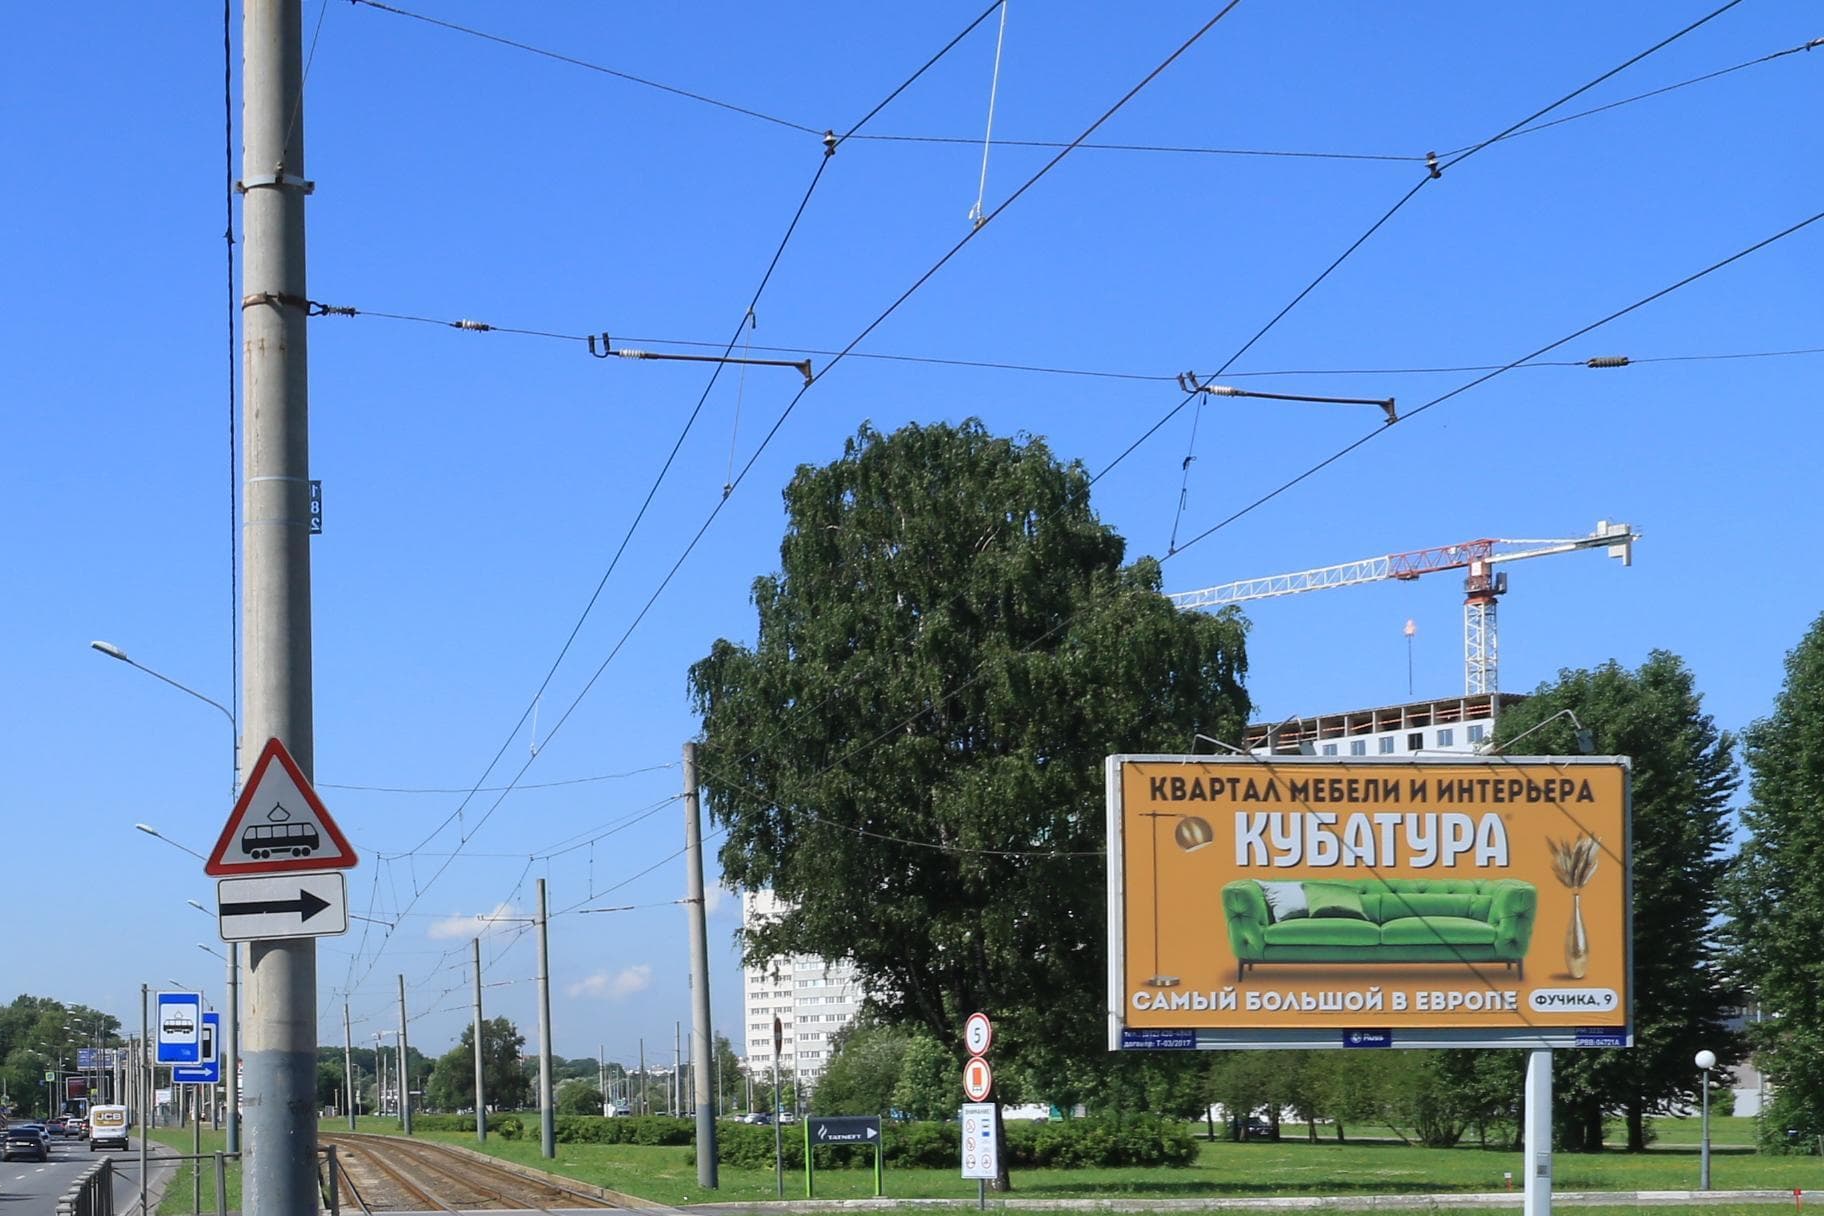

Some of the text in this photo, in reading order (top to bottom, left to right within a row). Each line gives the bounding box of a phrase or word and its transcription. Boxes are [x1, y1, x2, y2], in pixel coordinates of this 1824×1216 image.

[1149, 777, 1595, 803] КВАРТАЛ МЕБЕЛИ И ИНТЕРЬЕРА
[1234, 811, 1509, 868] КУБАТУРА
[1132, 986, 1518, 1011] САМЫЙ БОЛЬШОЙ В ЕВРОПЕ
[1534, 993, 1613, 1006] ФУЧИКА, 9
[974, 1027, 981, 1044] 5
[97, 1112, 122, 1121] JCB
